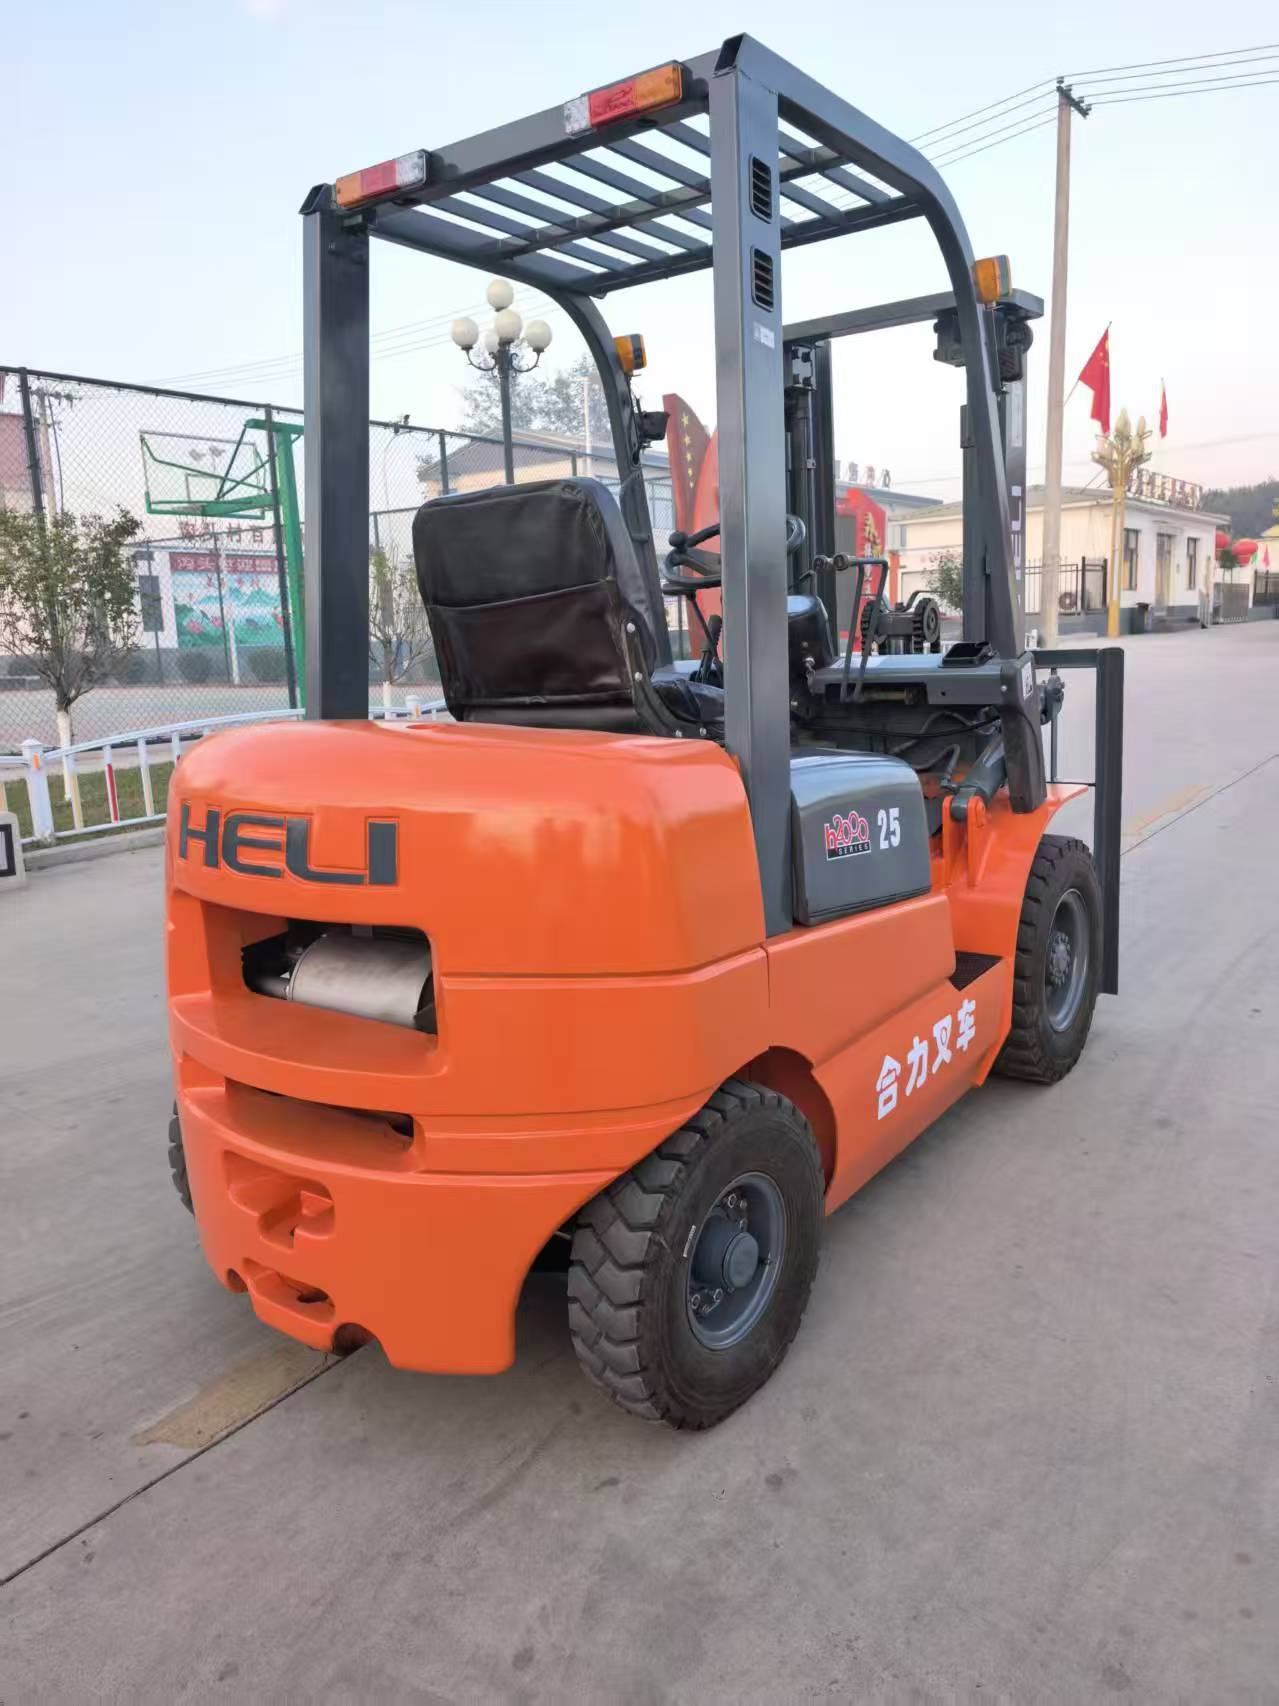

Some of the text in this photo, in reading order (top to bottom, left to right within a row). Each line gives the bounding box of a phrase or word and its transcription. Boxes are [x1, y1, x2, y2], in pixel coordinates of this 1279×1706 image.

[179, 803, 397, 884] HELI
[824, 811, 870, 849] h2000
[878, 807, 901, 849] 25
[838, 843, 869, 856] SERIES
[876, 999, 976, 1120] 合力叉车
